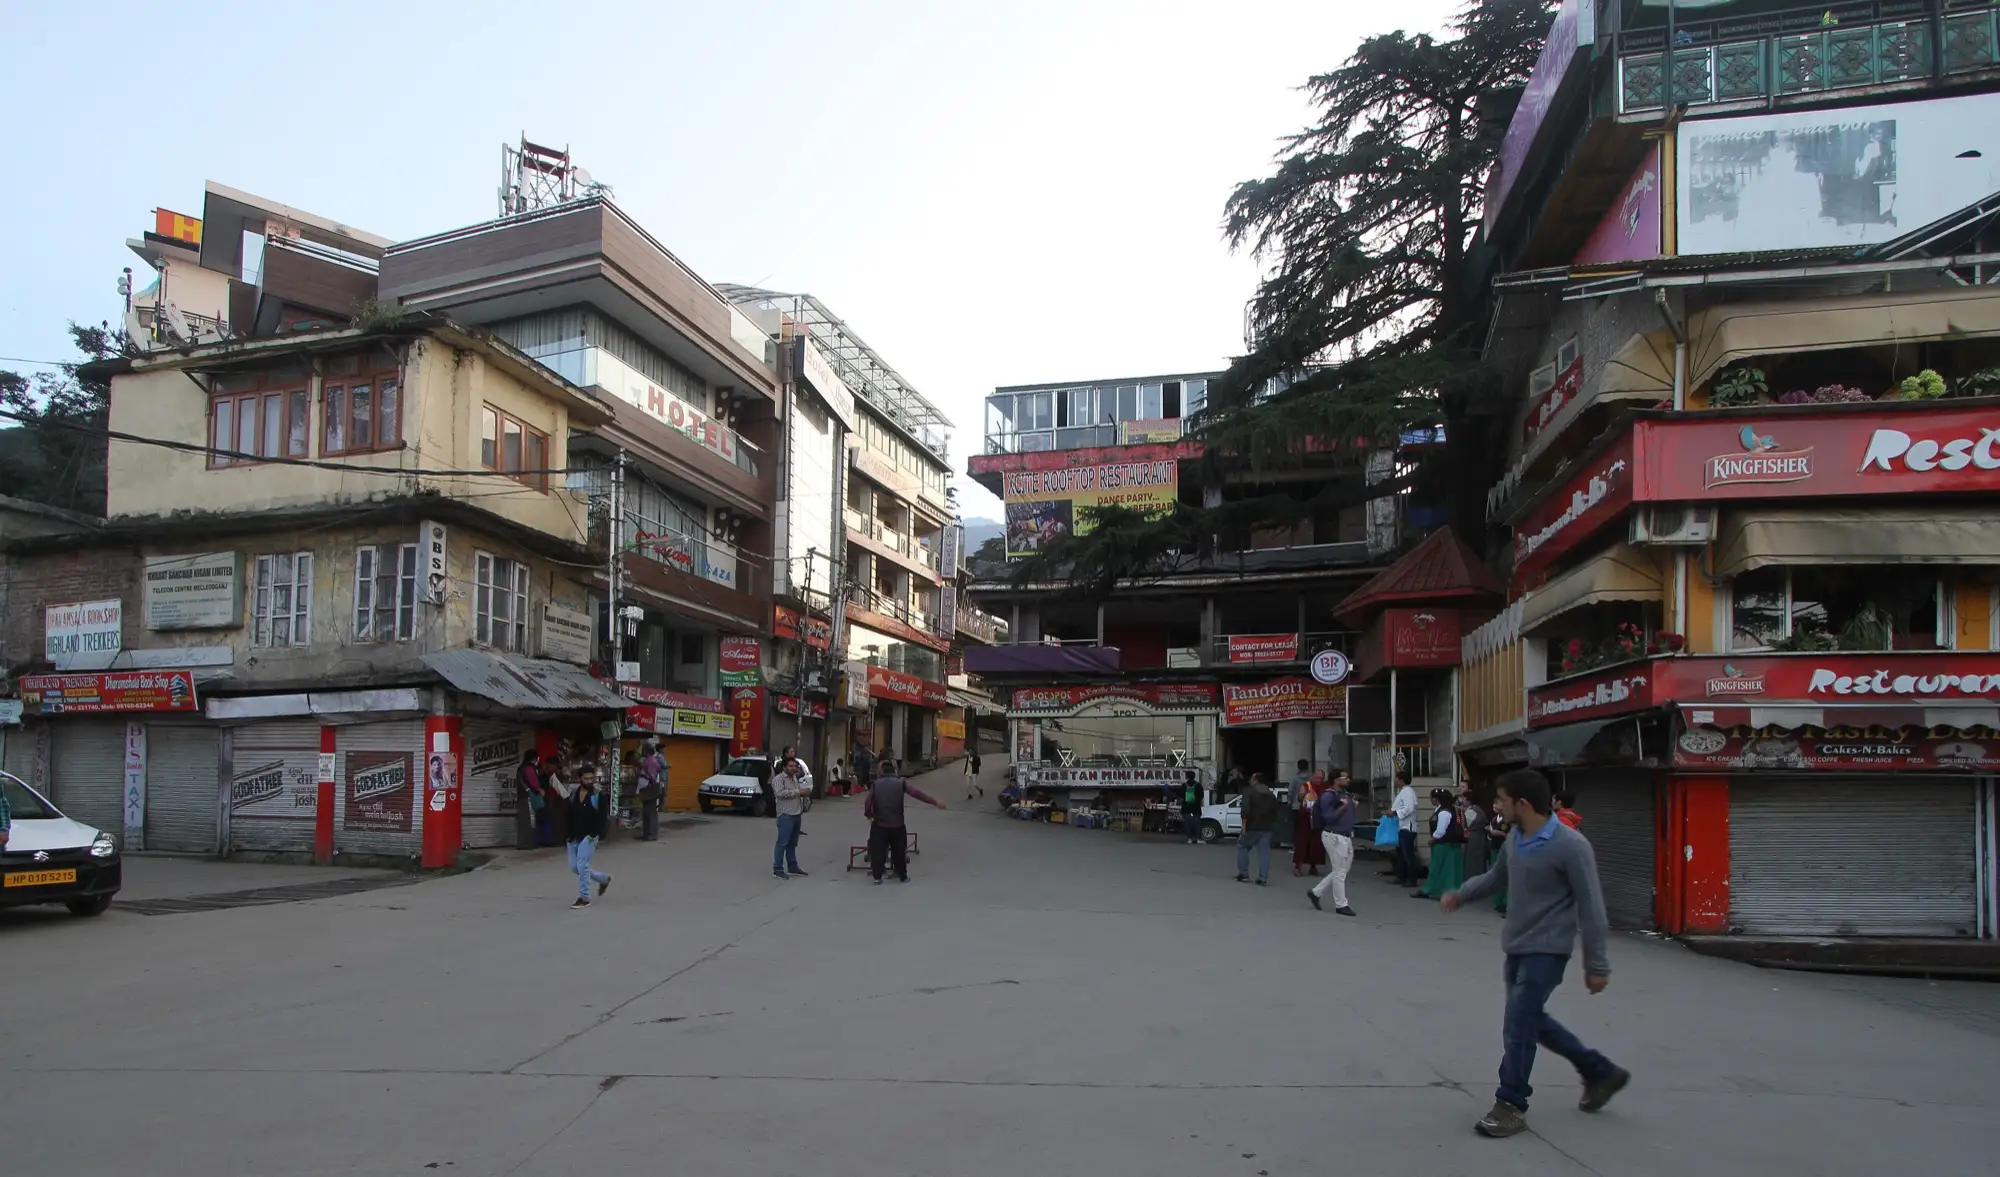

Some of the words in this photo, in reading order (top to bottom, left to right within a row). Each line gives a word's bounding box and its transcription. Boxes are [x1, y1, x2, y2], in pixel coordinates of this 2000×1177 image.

[647, 385, 731, 457] HOTEL
[1007, 471, 1039, 495] XCITE
[1043, 467, 1095, 493] ROOFTOP
[1099, 459, 1174, 489] RESTAURANT
[1712, 457, 1810, 478] KINGFISHER
[1097, 494, 1125, 506] DANCE
[83, 630, 120, 652] TREKKERS
[723, 635, 758, 645] HOTEL
[1231, 643, 1260, 651] CONTACT
[1260, 642, 1274, 650] FOR
[1320, 656, 1339, 668] BR
[140, 674, 155, 688] Book
[154, 674, 169, 692] Shop
[886, 675, 906, 692] Pizza
[907, 680, 920, 695] Hut
[1227, 683, 1303, 700] Tandoori
[1711, 679, 1763, 692] KINGFISHER
[648, 691, 684, 708] Asian
[739, 700, 749, 751] HOTEL
[131, 725, 143, 760] BUS
[356, 767, 404, 794] GODFATHER
[1036, 770, 1098, 781] TIBETAN
[1101, 770, 1131, 781] MINI
[1134, 769, 1182, 781] MARKE
[233, 770, 283, 800] GODFATHER
[128, 774, 141, 821] TAXI
[12, 875, 26, 884] HP
[49, 871, 74, 881] 5215
